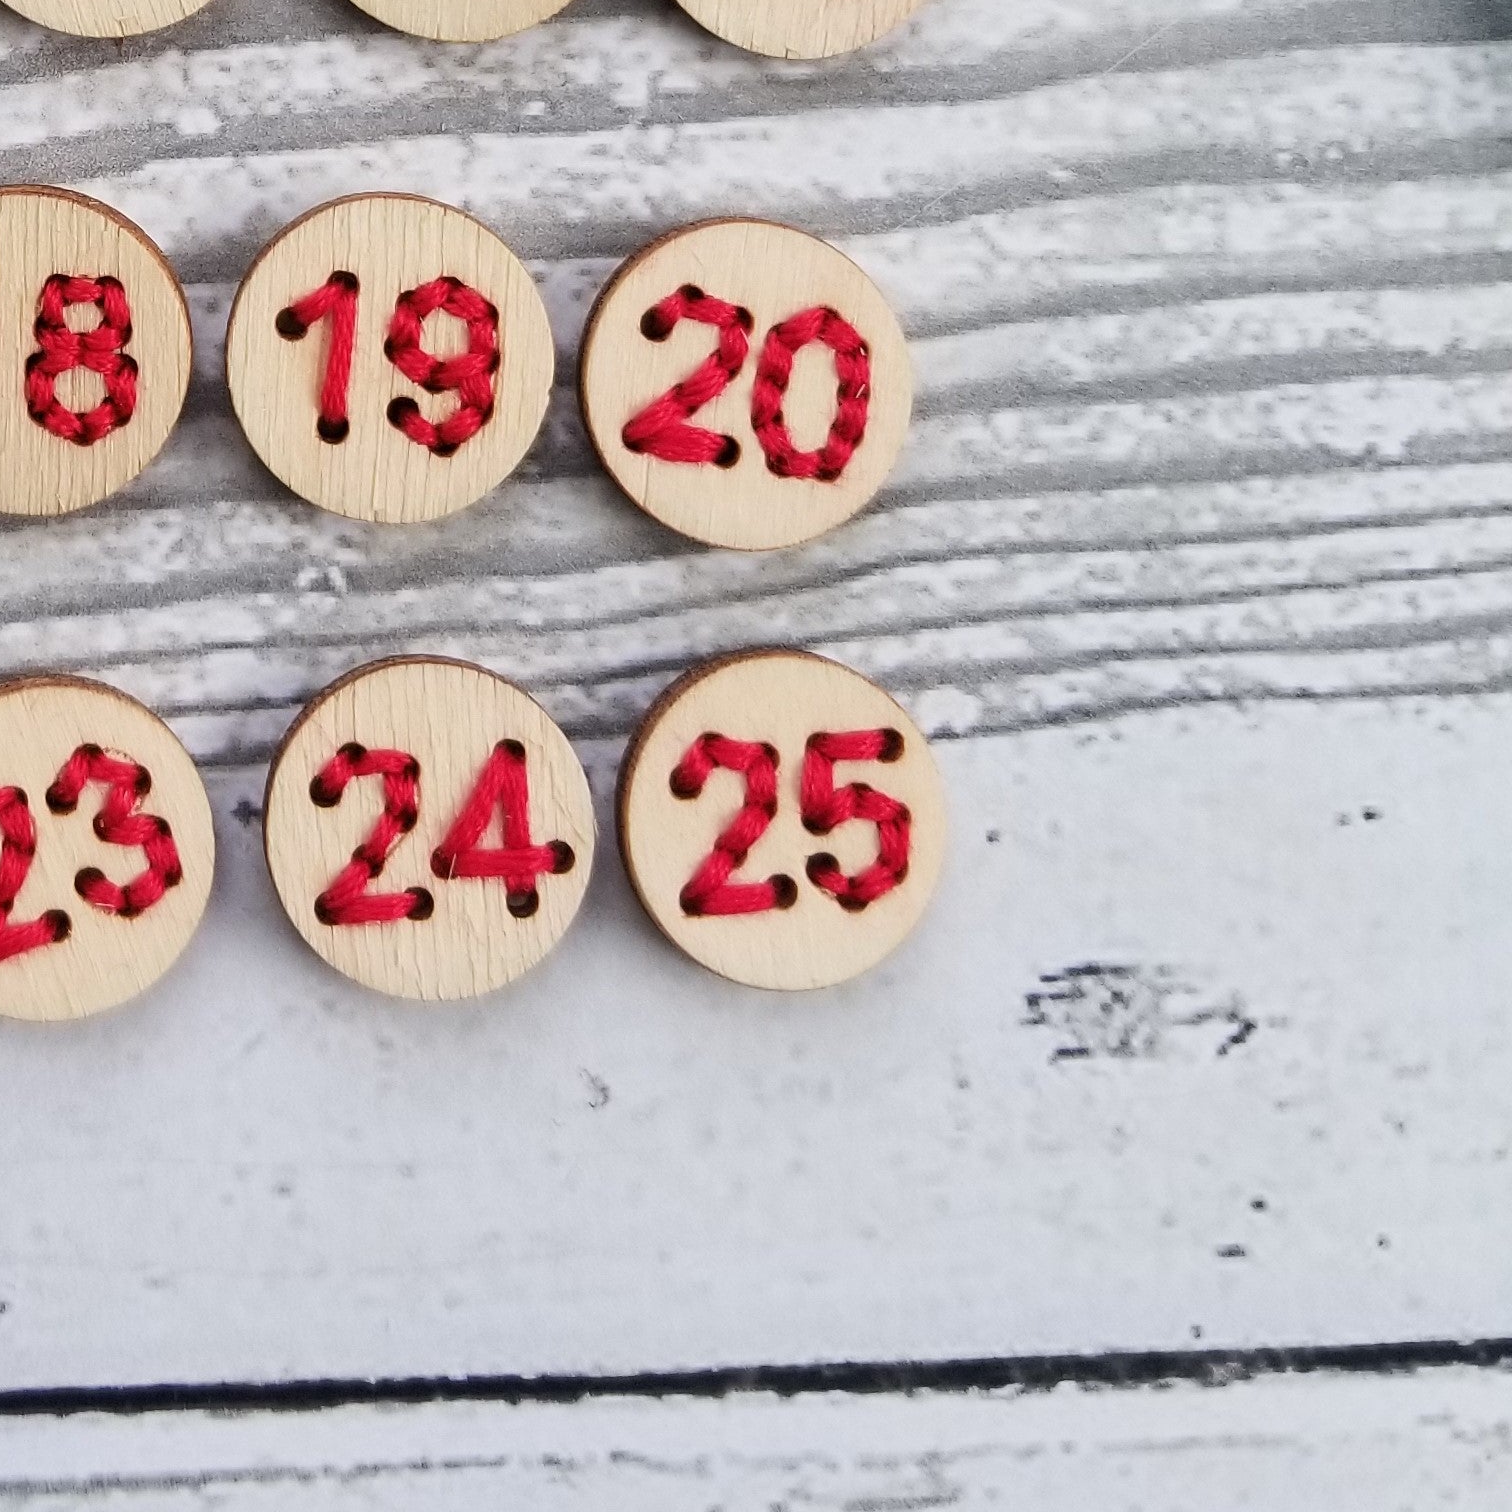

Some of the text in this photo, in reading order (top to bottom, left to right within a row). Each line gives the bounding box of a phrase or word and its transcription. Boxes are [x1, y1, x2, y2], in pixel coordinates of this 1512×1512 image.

[276, 271, 501, 456] 19
[622, 285, 871, 483] 20
[310, 739, 573, 928] 24
[670, 728, 912, 917] 25
